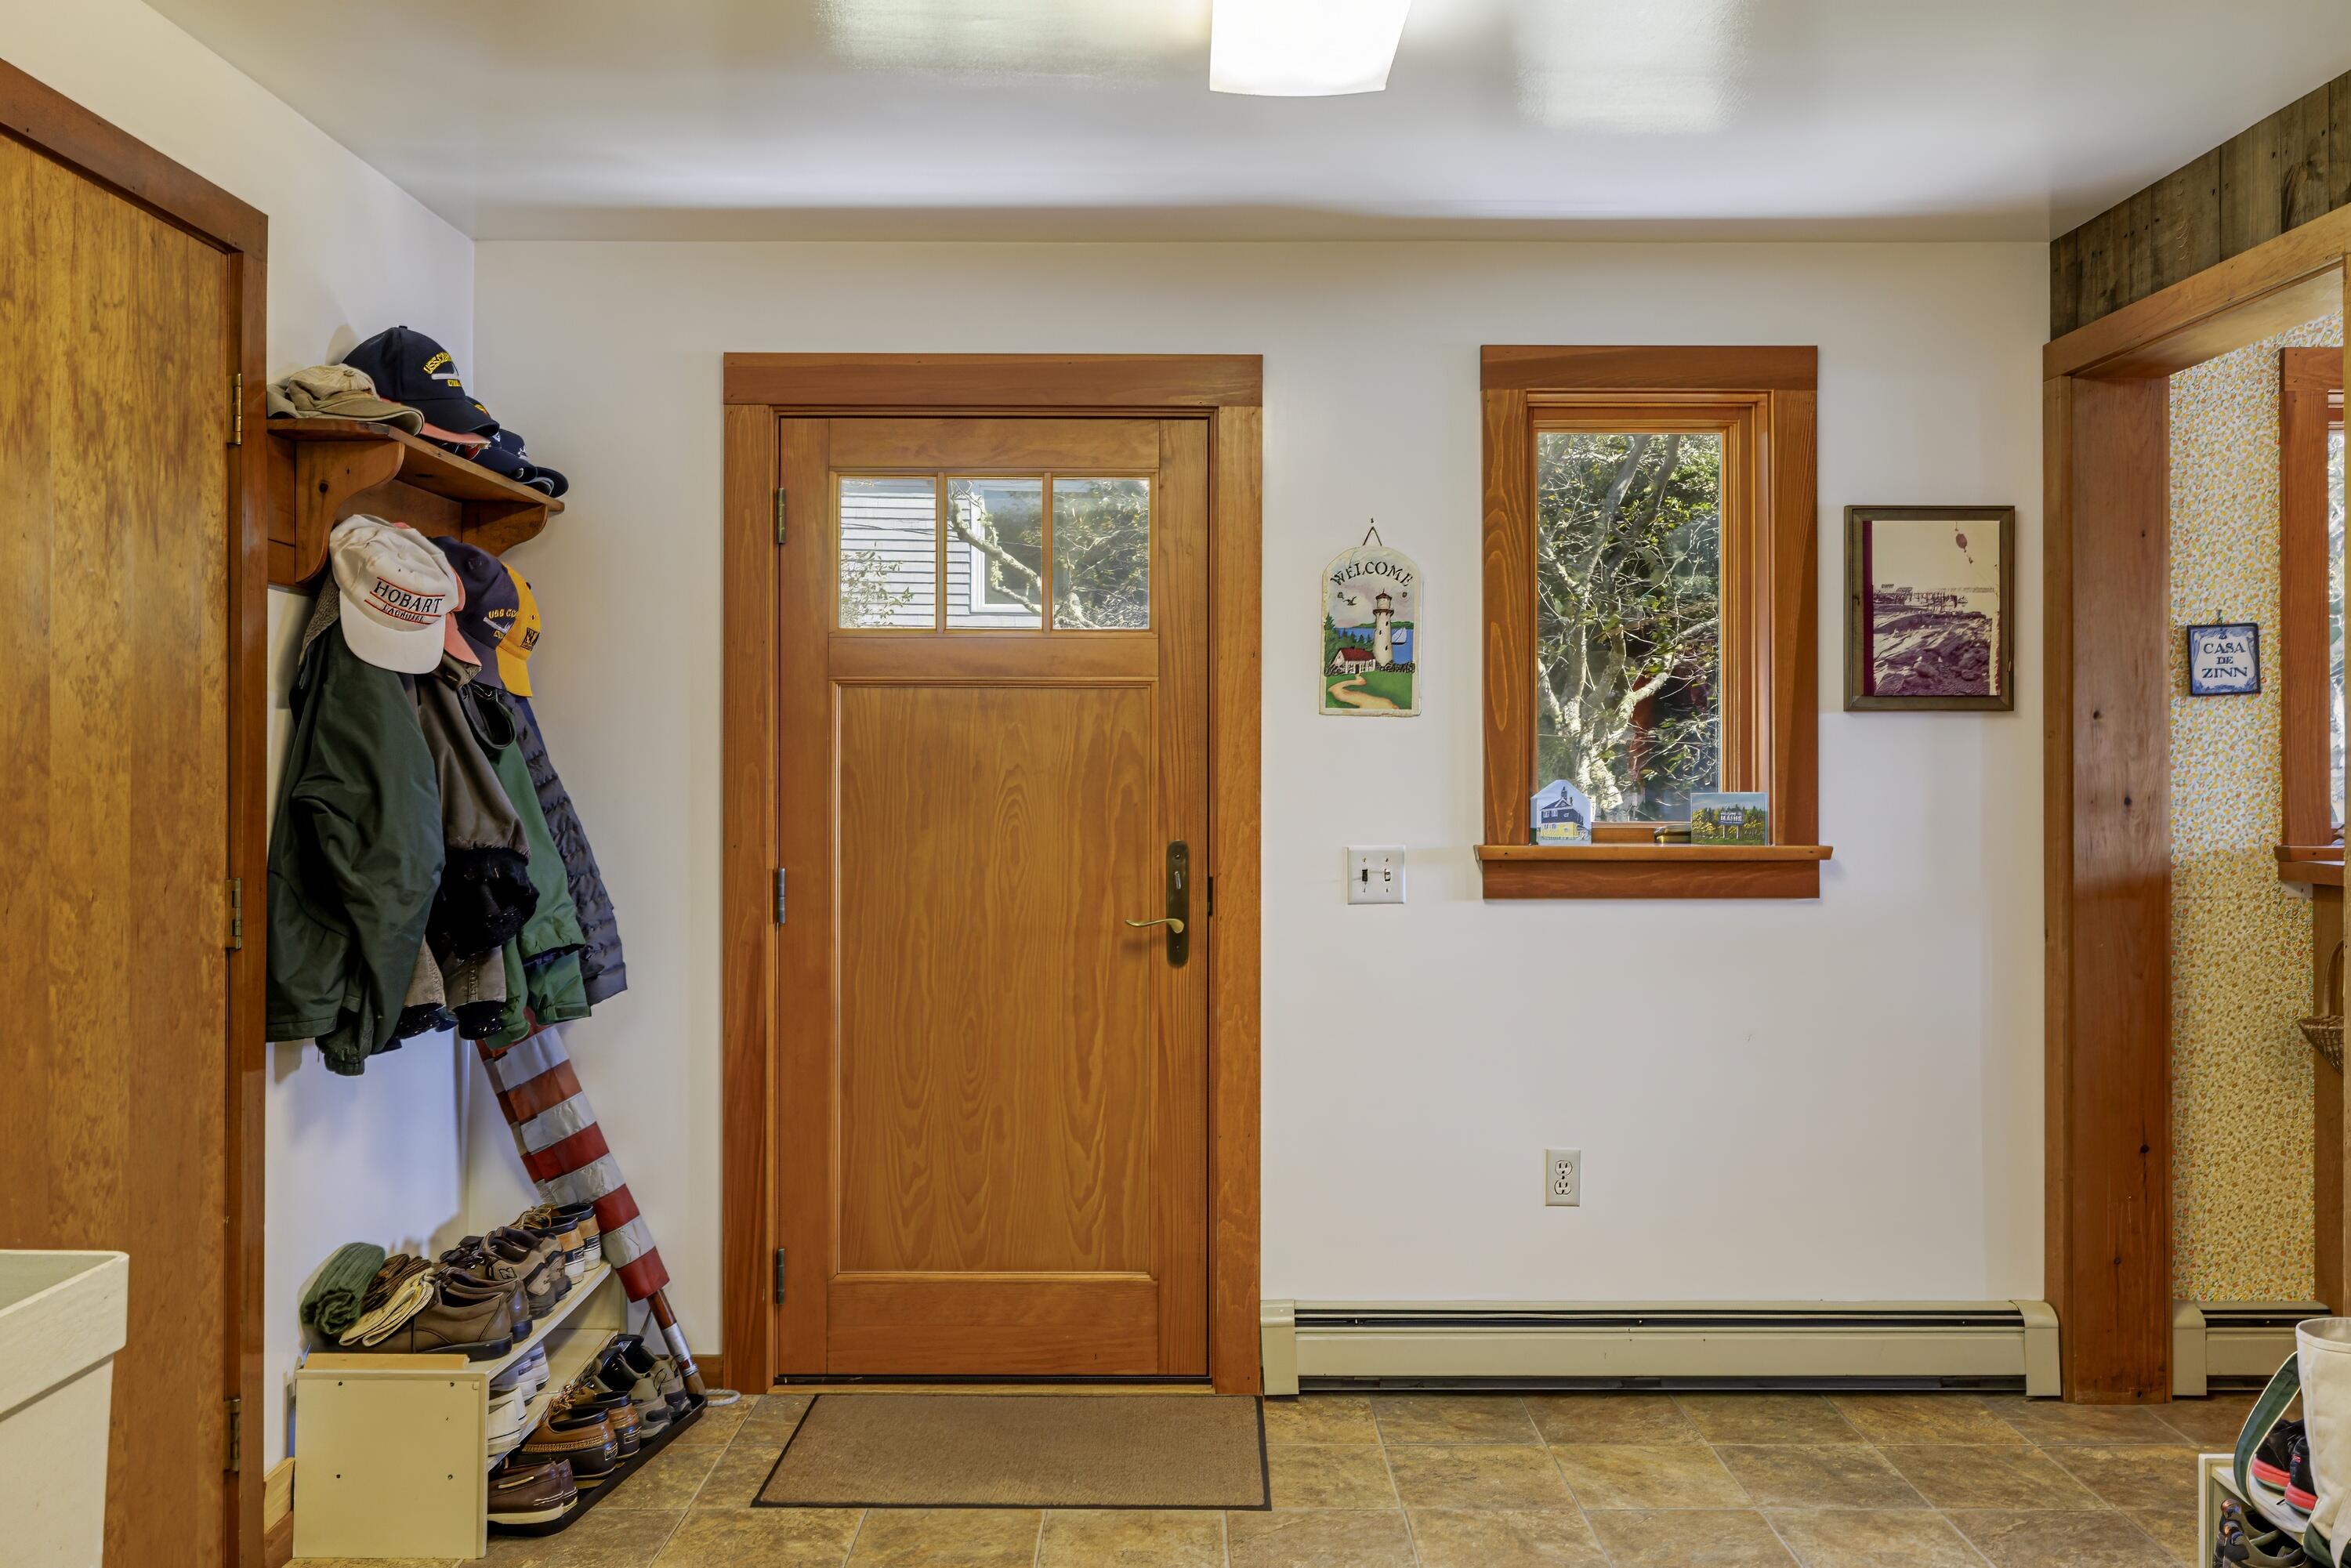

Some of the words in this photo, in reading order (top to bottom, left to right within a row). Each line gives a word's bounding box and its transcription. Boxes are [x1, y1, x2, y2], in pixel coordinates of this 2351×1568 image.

[1330, 561, 1413, 586] WELCOME
[373, 581, 443, 614] HOBART
[2204, 642, 2246, 654] CASA
[2201, 667, 2248, 678] ZINN
